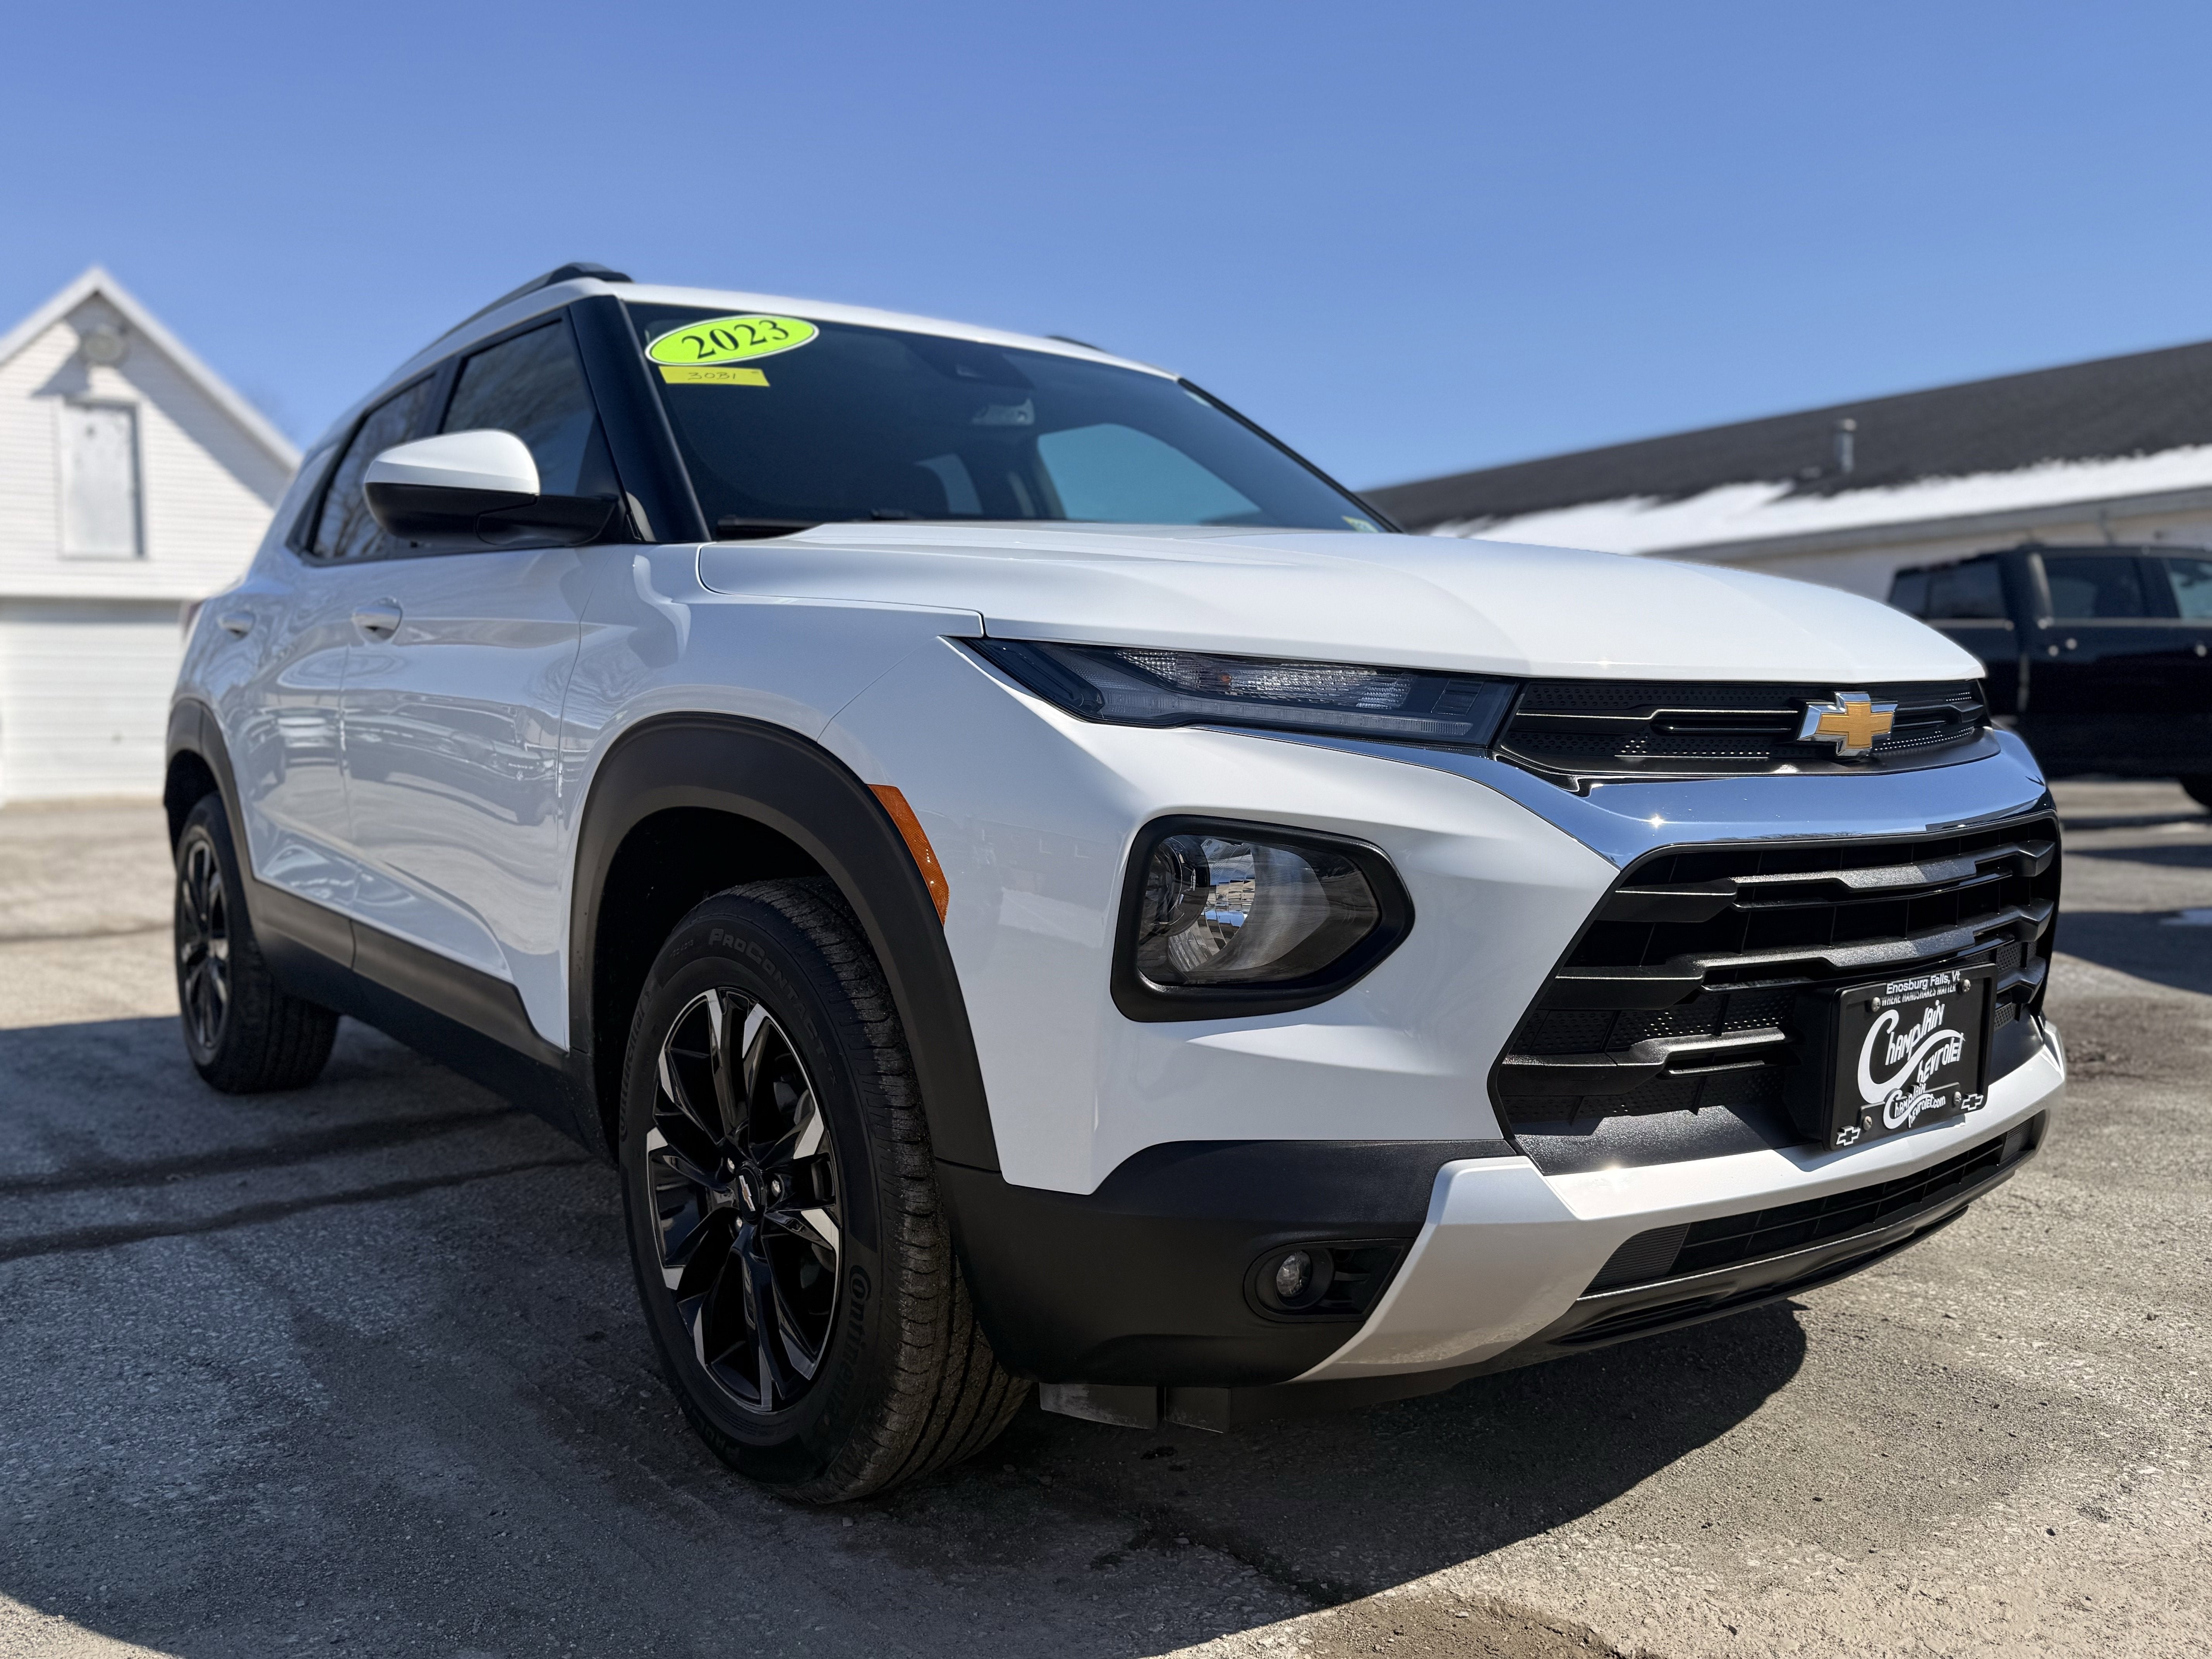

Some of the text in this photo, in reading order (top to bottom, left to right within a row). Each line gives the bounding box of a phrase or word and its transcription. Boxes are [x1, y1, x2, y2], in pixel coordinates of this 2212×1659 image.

[682, 320, 789, 359] 2023
[1886, 970, 1960, 994] Enosburg Falls, Vt
